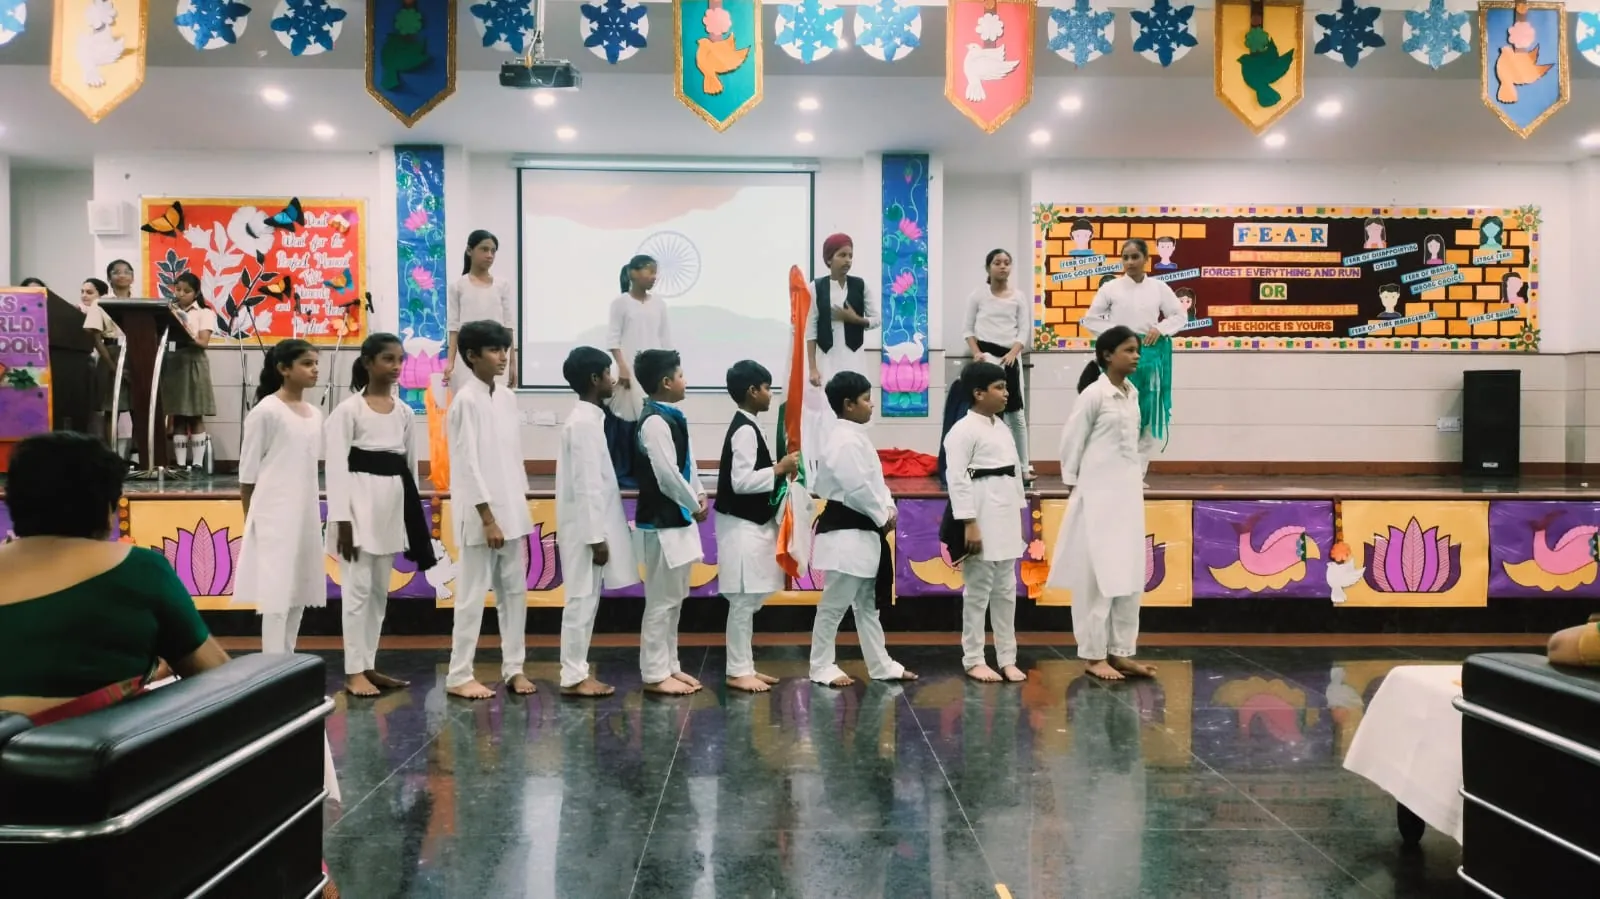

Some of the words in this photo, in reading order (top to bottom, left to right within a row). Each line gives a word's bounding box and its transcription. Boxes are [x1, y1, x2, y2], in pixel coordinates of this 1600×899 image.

[1202, 267, 1243, 277] FORGET
[1246, 267, 1311, 277] EVERYTHING
[1313, 268, 1336, 277] AND
[1338, 268, 1360, 277] RUN
[1261, 284, 1286, 298] OR
[1219, 322, 1242, 331] THE
[1243, 321, 1281, 331] CHOICE
[1283, 321, 1294, 330] IS
[1295, 321, 1332, 330] YOURS
